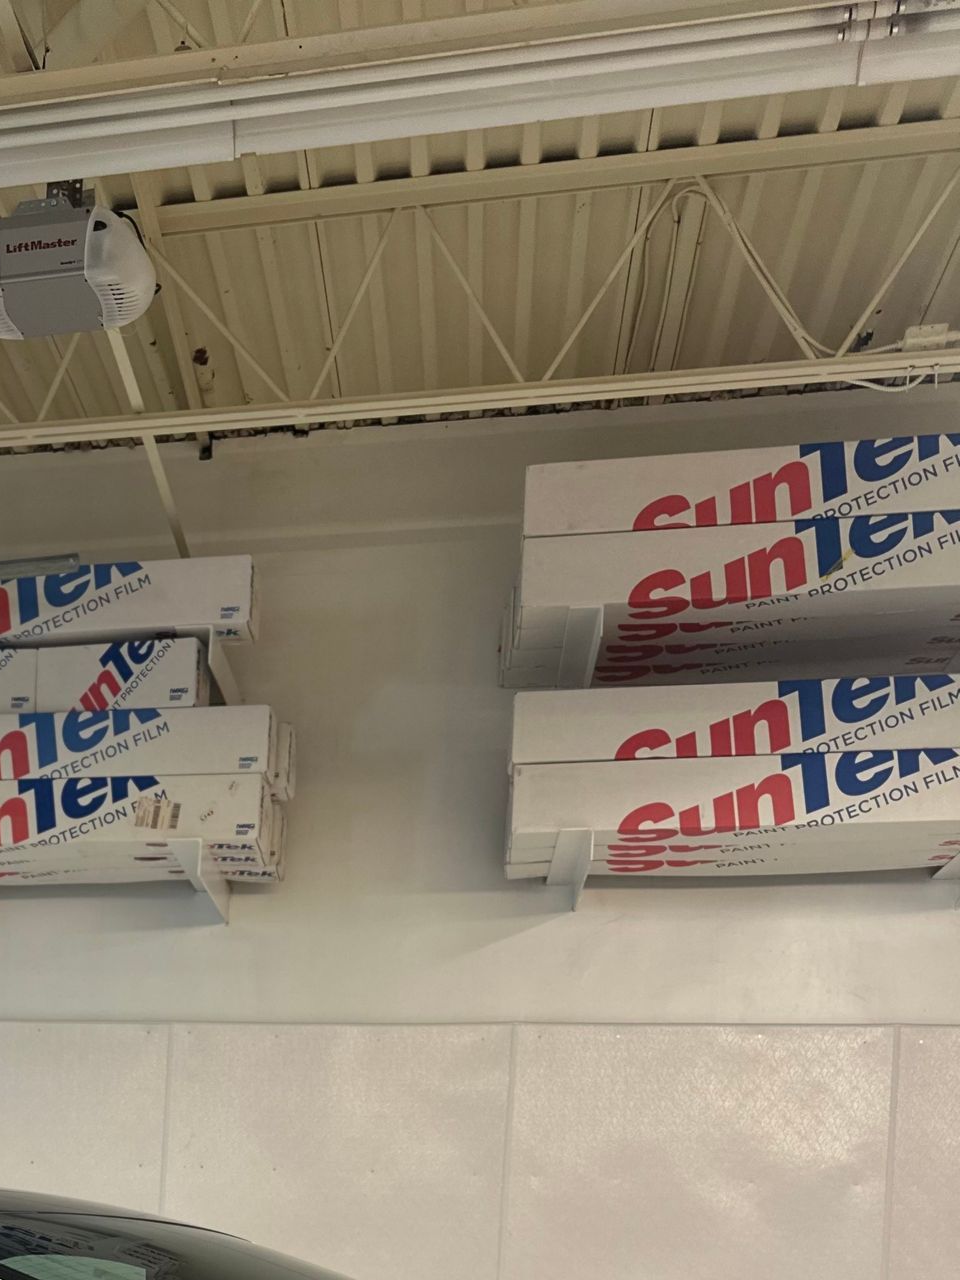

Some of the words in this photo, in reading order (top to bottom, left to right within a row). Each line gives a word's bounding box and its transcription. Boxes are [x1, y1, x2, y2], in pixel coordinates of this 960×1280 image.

[6, 238, 77, 254] LiftMaster
[942, 452, 960, 473] FI
[114, 574, 151, 600] FILM
[745, 593, 800, 610] PAINT
[808, 541, 932, 599] PROTECTION
[121, 641, 172, 702] PROTECTION
[40, 739, 128, 780] OTECTION
[133, 721, 170, 747] FILM
[804, 708, 914, 755] OTECTION
[32, 809, 128, 848] PROTECTION
[733, 825, 789, 838] PAINT
[795, 781, 919, 831] PROTECTION
